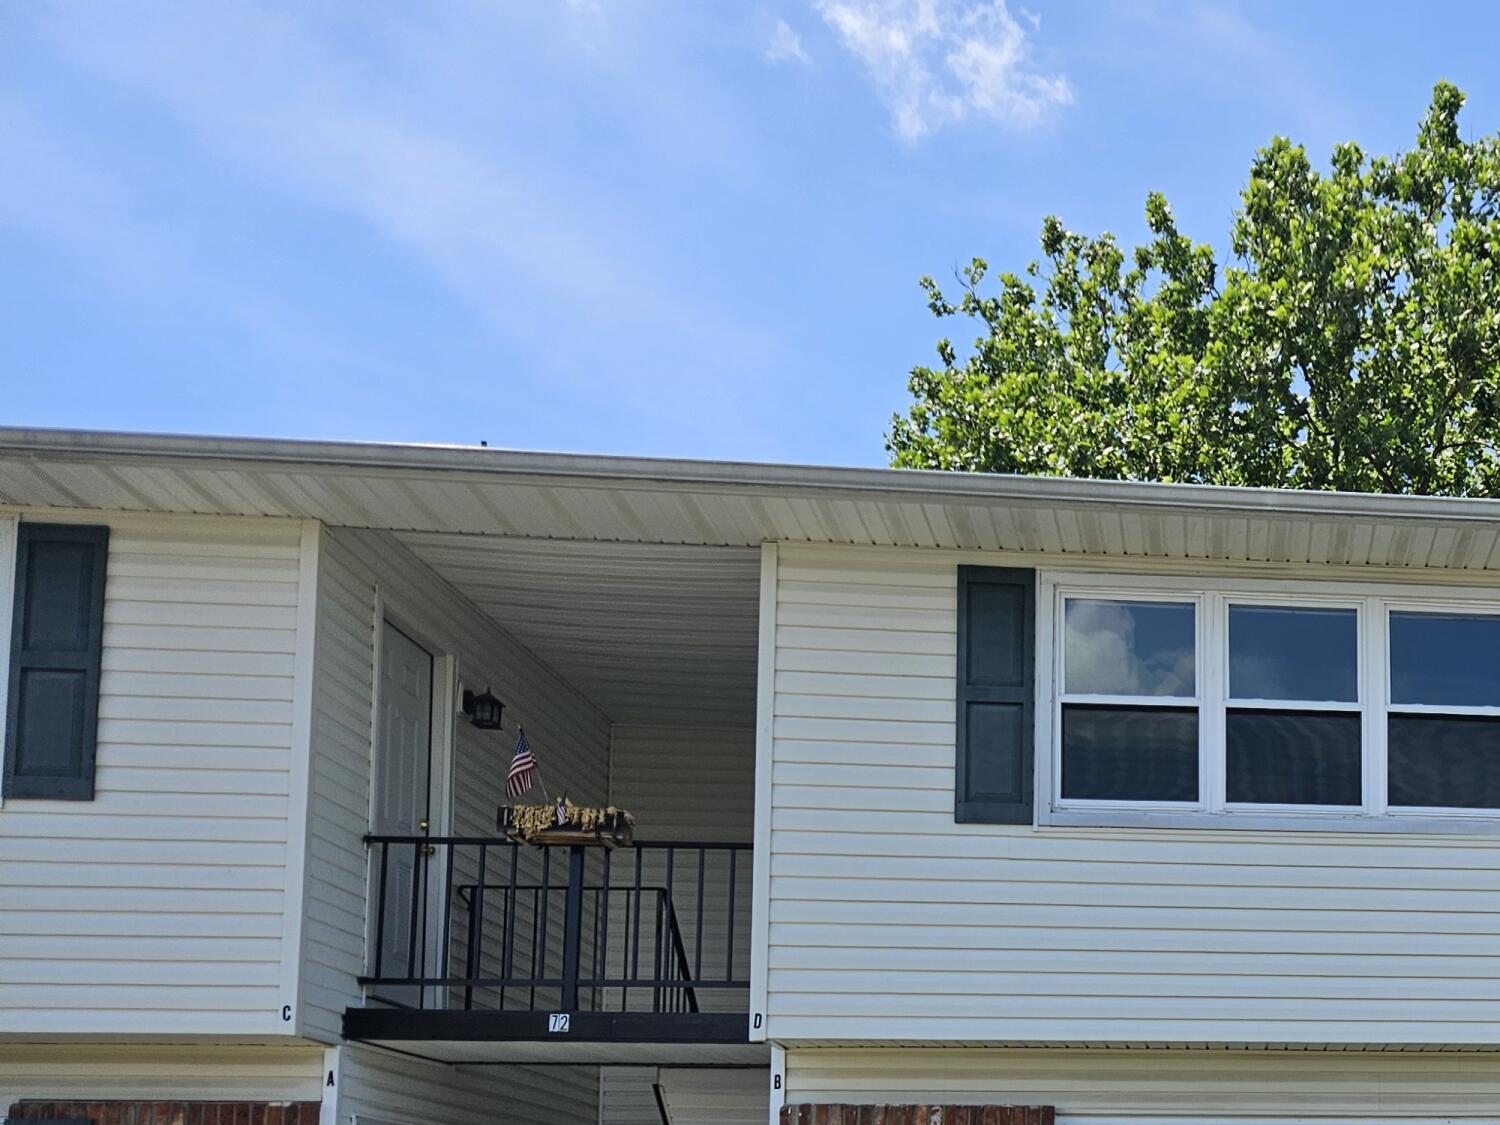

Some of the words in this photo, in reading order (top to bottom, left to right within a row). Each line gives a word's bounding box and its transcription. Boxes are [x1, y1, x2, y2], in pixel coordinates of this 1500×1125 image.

[282, 1005, 292, 1022] C
[753, 1012, 763, 1029] D
[551, 1014, 569, 1031] 72
[326, 1070, 335, 1087] A
[773, 1074, 782, 1090] B
